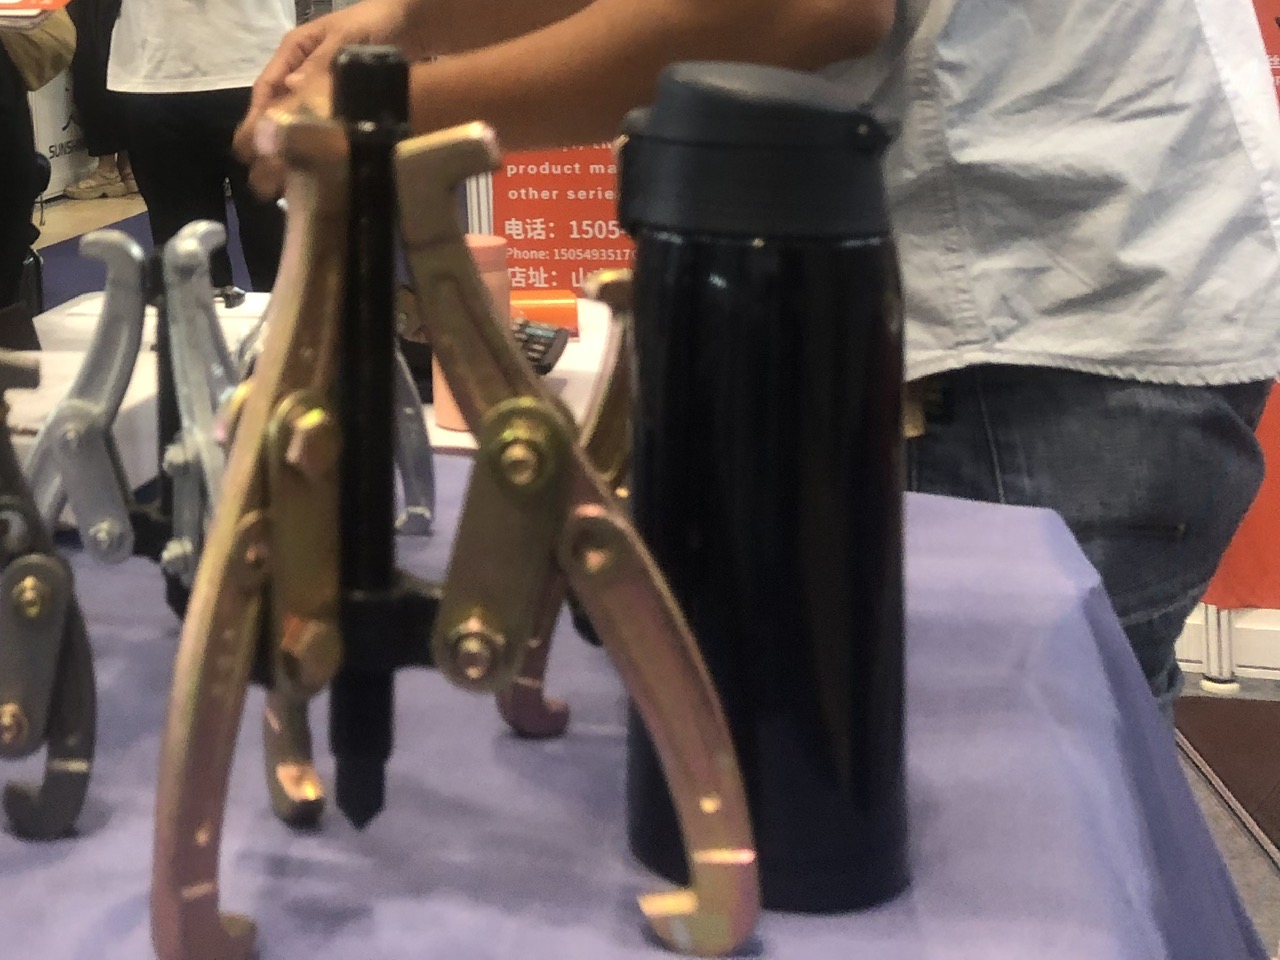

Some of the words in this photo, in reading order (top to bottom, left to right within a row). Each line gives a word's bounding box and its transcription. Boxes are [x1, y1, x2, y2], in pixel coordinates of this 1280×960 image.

[506, 161, 581, 178] product
[508, 187, 559, 200] other
[569, 220, 628, 239] 1505
[506, 247, 550, 261] Phone:
